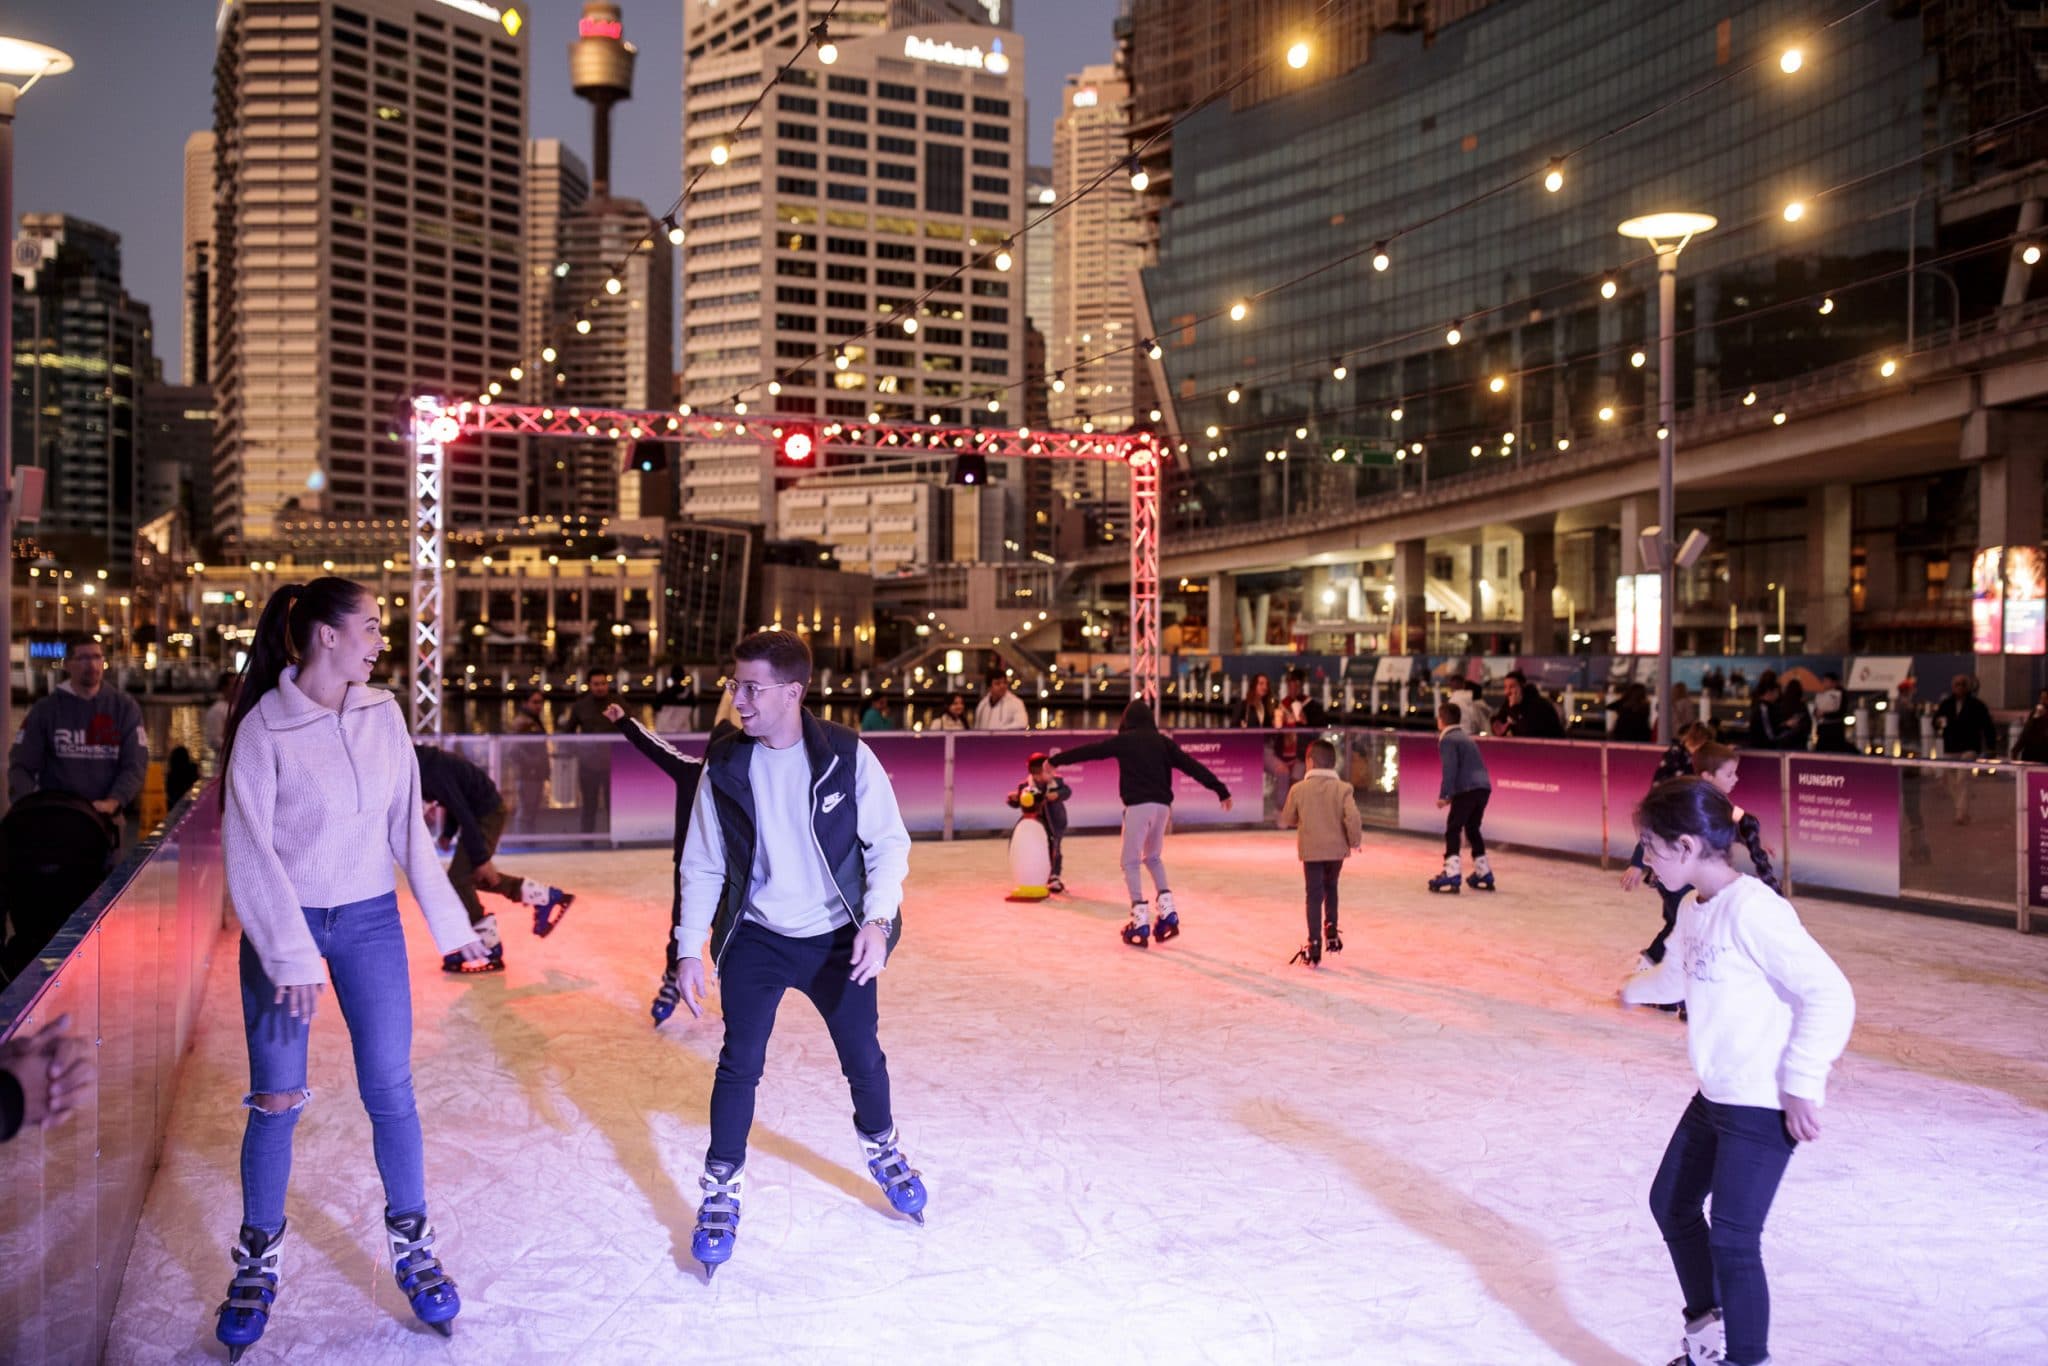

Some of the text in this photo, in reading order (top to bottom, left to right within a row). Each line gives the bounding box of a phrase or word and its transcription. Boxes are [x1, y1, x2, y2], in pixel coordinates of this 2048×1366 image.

[1798, 773, 1845, 788] HUNGRY?
[1798, 793, 1816, 803] Hold
[1834, 798, 1852, 808] your
[1821, 808, 1835, 818] and
[1836, 810, 1858, 820] check
[1859, 813, 1873, 821] out
[1799, 819, 1873, 835] darlingharbour.com
